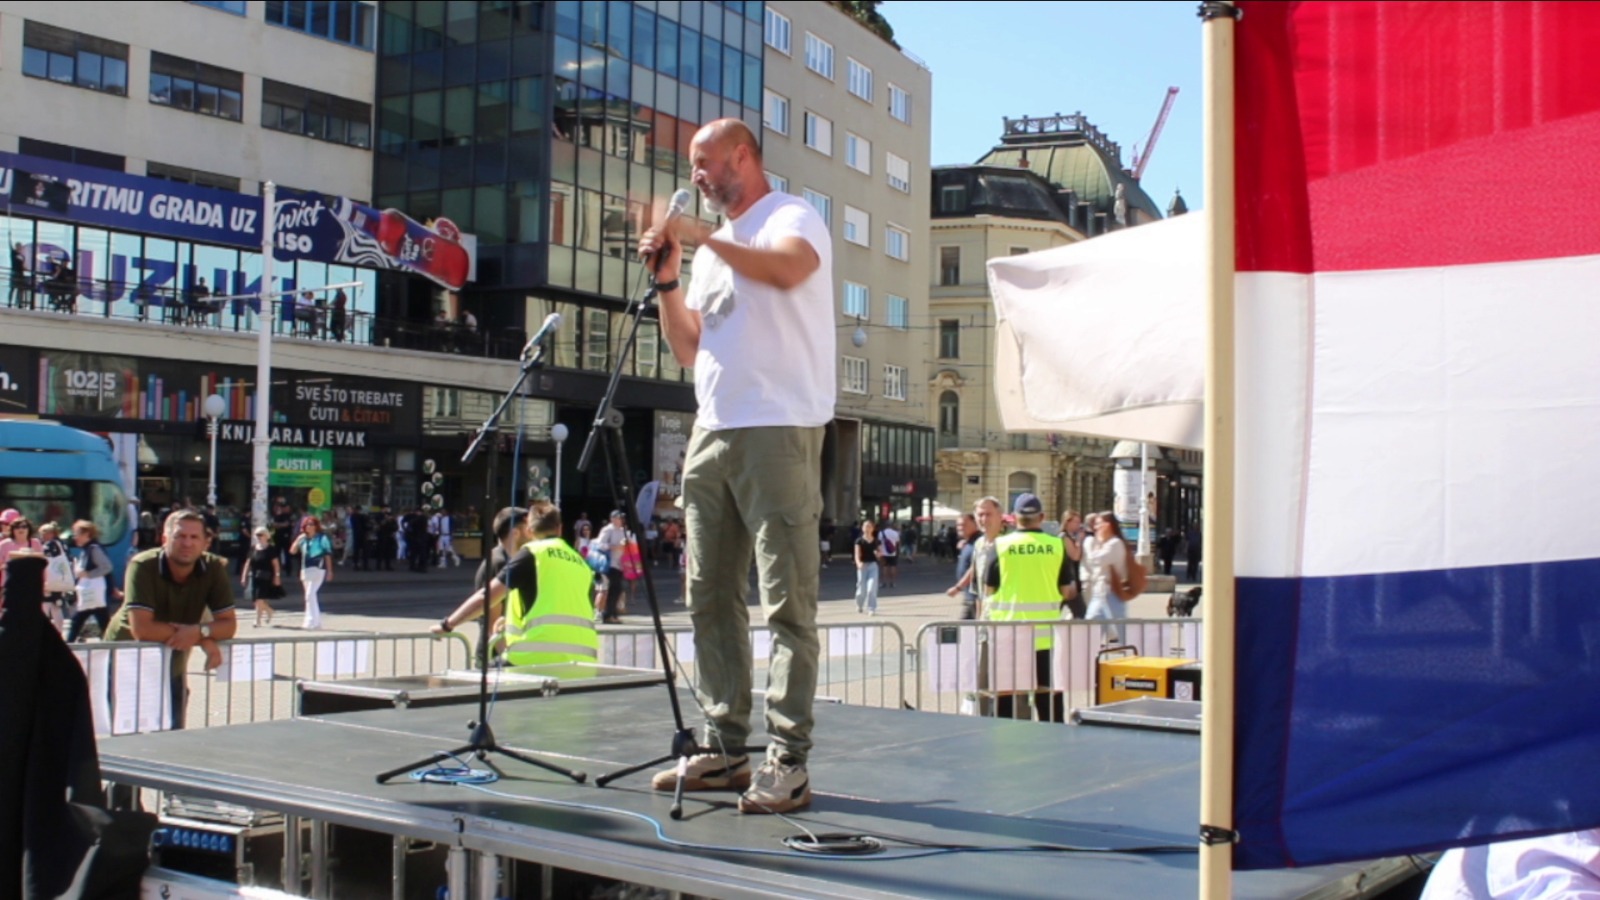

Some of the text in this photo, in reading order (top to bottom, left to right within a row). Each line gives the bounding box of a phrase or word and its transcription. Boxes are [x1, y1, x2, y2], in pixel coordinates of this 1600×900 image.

[66, 178, 143, 216] RITMU
[149, 194, 225, 229] GRADA
[230, 208, 256, 234] UZ
[296, 384, 403, 407] SVE ŠTO TREBATE
[309, 402, 340, 422] ČUTI
[221, 424, 366, 448] KNJARA LJEVAK
[1008, 544, 1055, 555] REDAR
